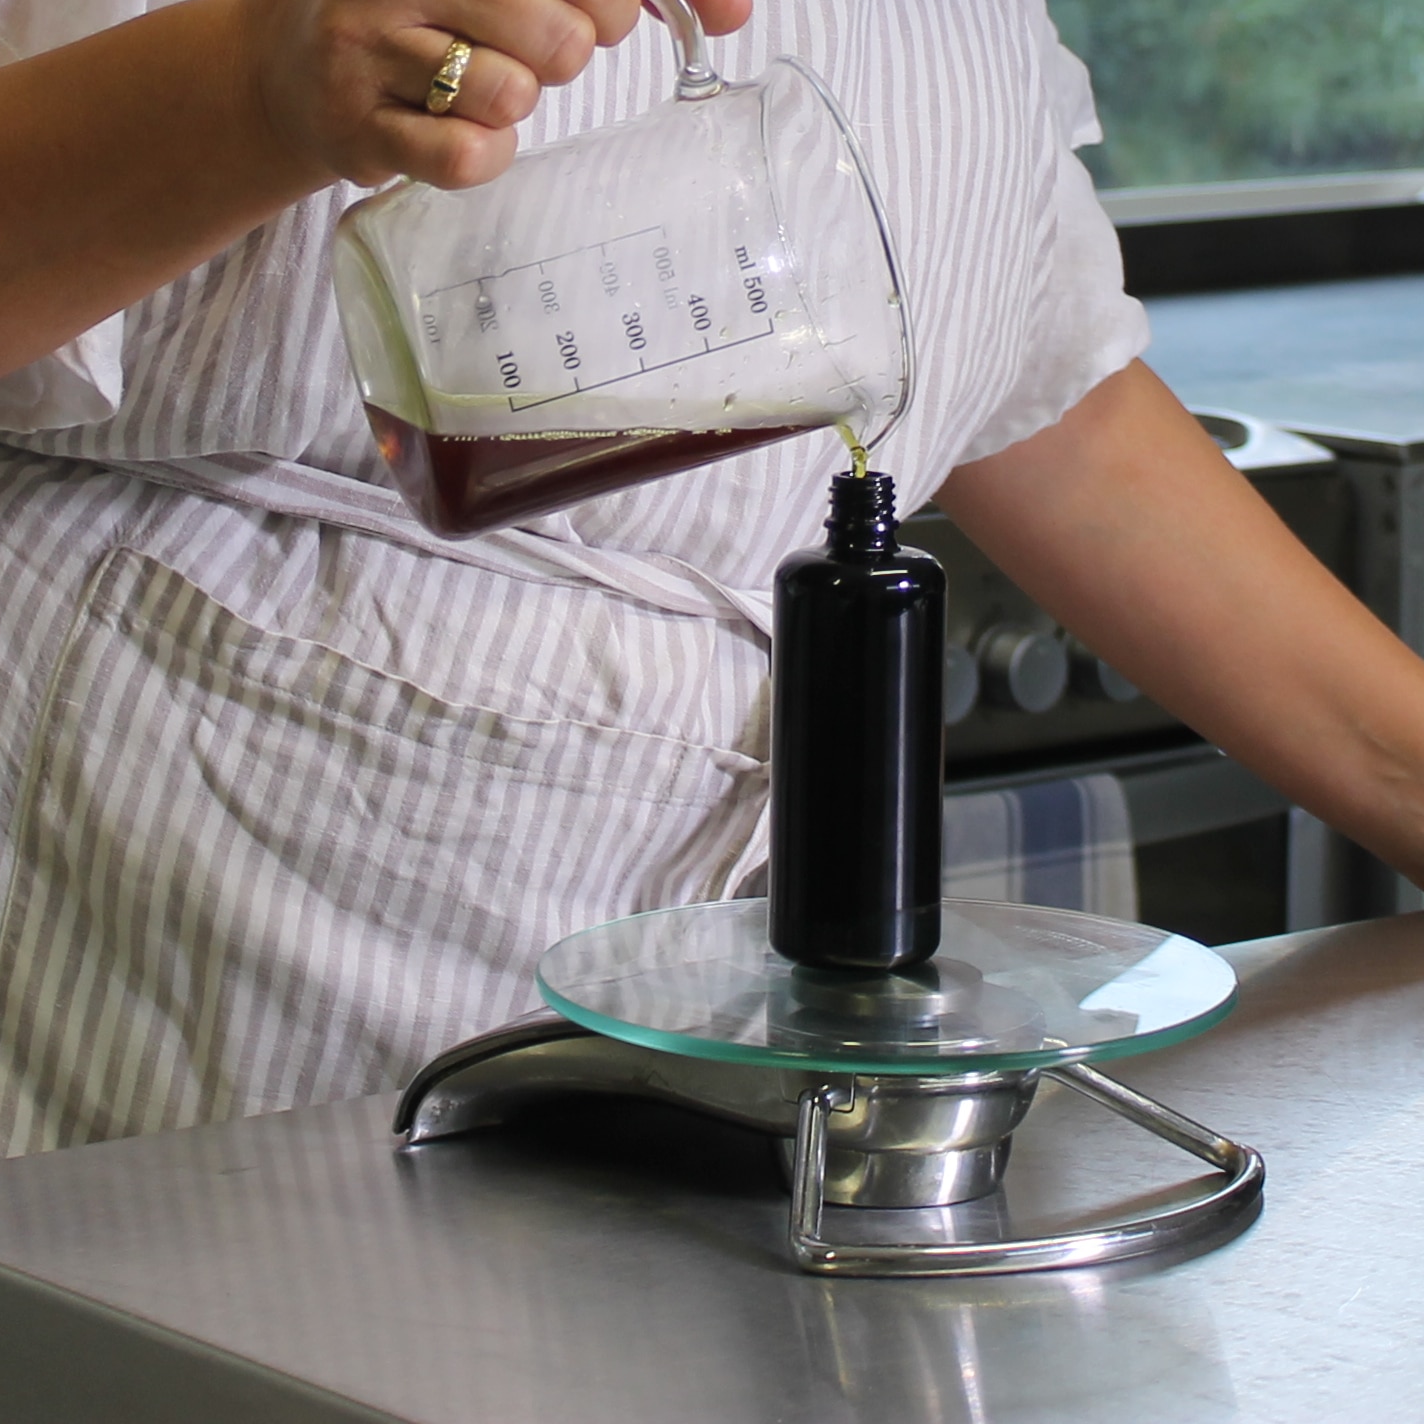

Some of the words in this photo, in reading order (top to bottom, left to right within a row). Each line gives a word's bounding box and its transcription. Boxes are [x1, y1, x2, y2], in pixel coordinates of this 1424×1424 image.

[734, 245, 756, 272] ml
[687, 293, 712, 332] 400
[743, 276, 769, 315] 500
[555, 331, 581, 371] 200
[621, 312, 647, 351] 300
[495, 350, 522, 389] 100
